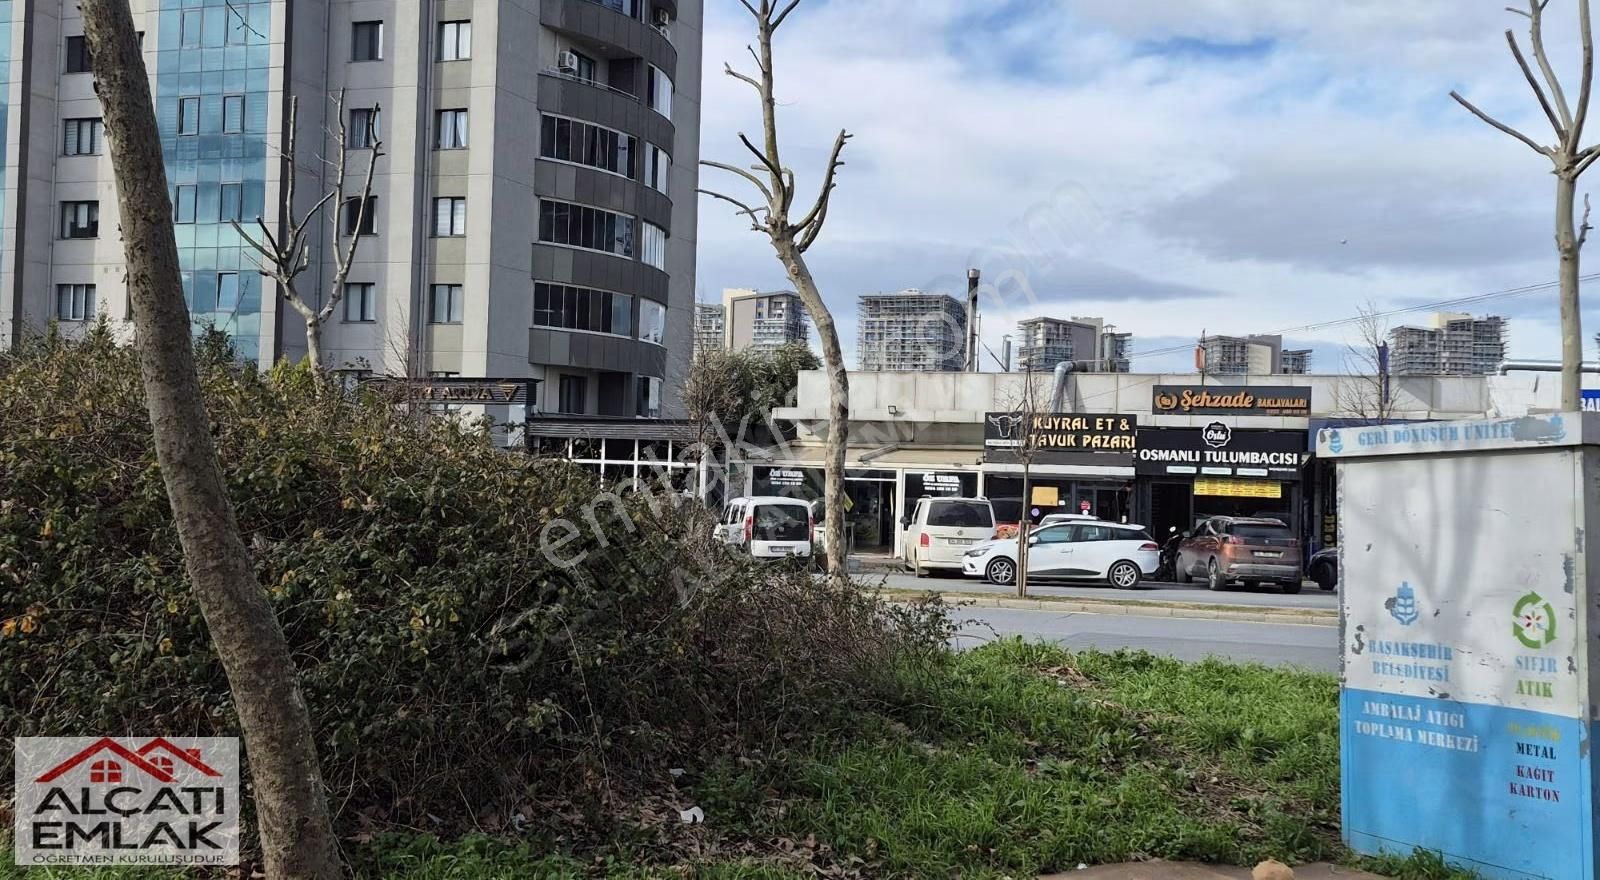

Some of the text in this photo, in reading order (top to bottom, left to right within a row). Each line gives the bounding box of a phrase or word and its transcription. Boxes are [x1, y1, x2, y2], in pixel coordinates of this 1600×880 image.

[1180, 389, 1254, 412] Şehzade
[1095, 418, 1115, 431] ET
[1119, 418, 1130, 431] &
[1029, 434, 1077, 448] TAVUK
[1082, 435, 1136, 449] PAZARI
[1139, 448, 1298, 466] OSMANLI TULUMBACISI
[1515, 679, 1553, 698] ATIK
[1354, 720, 1413, 742] TOPLAMA
[1417, 729, 1479, 753] MERKEZİ
[1515, 741, 1557, 760] METAL
[1509, 782, 1560, 803] KARTON
